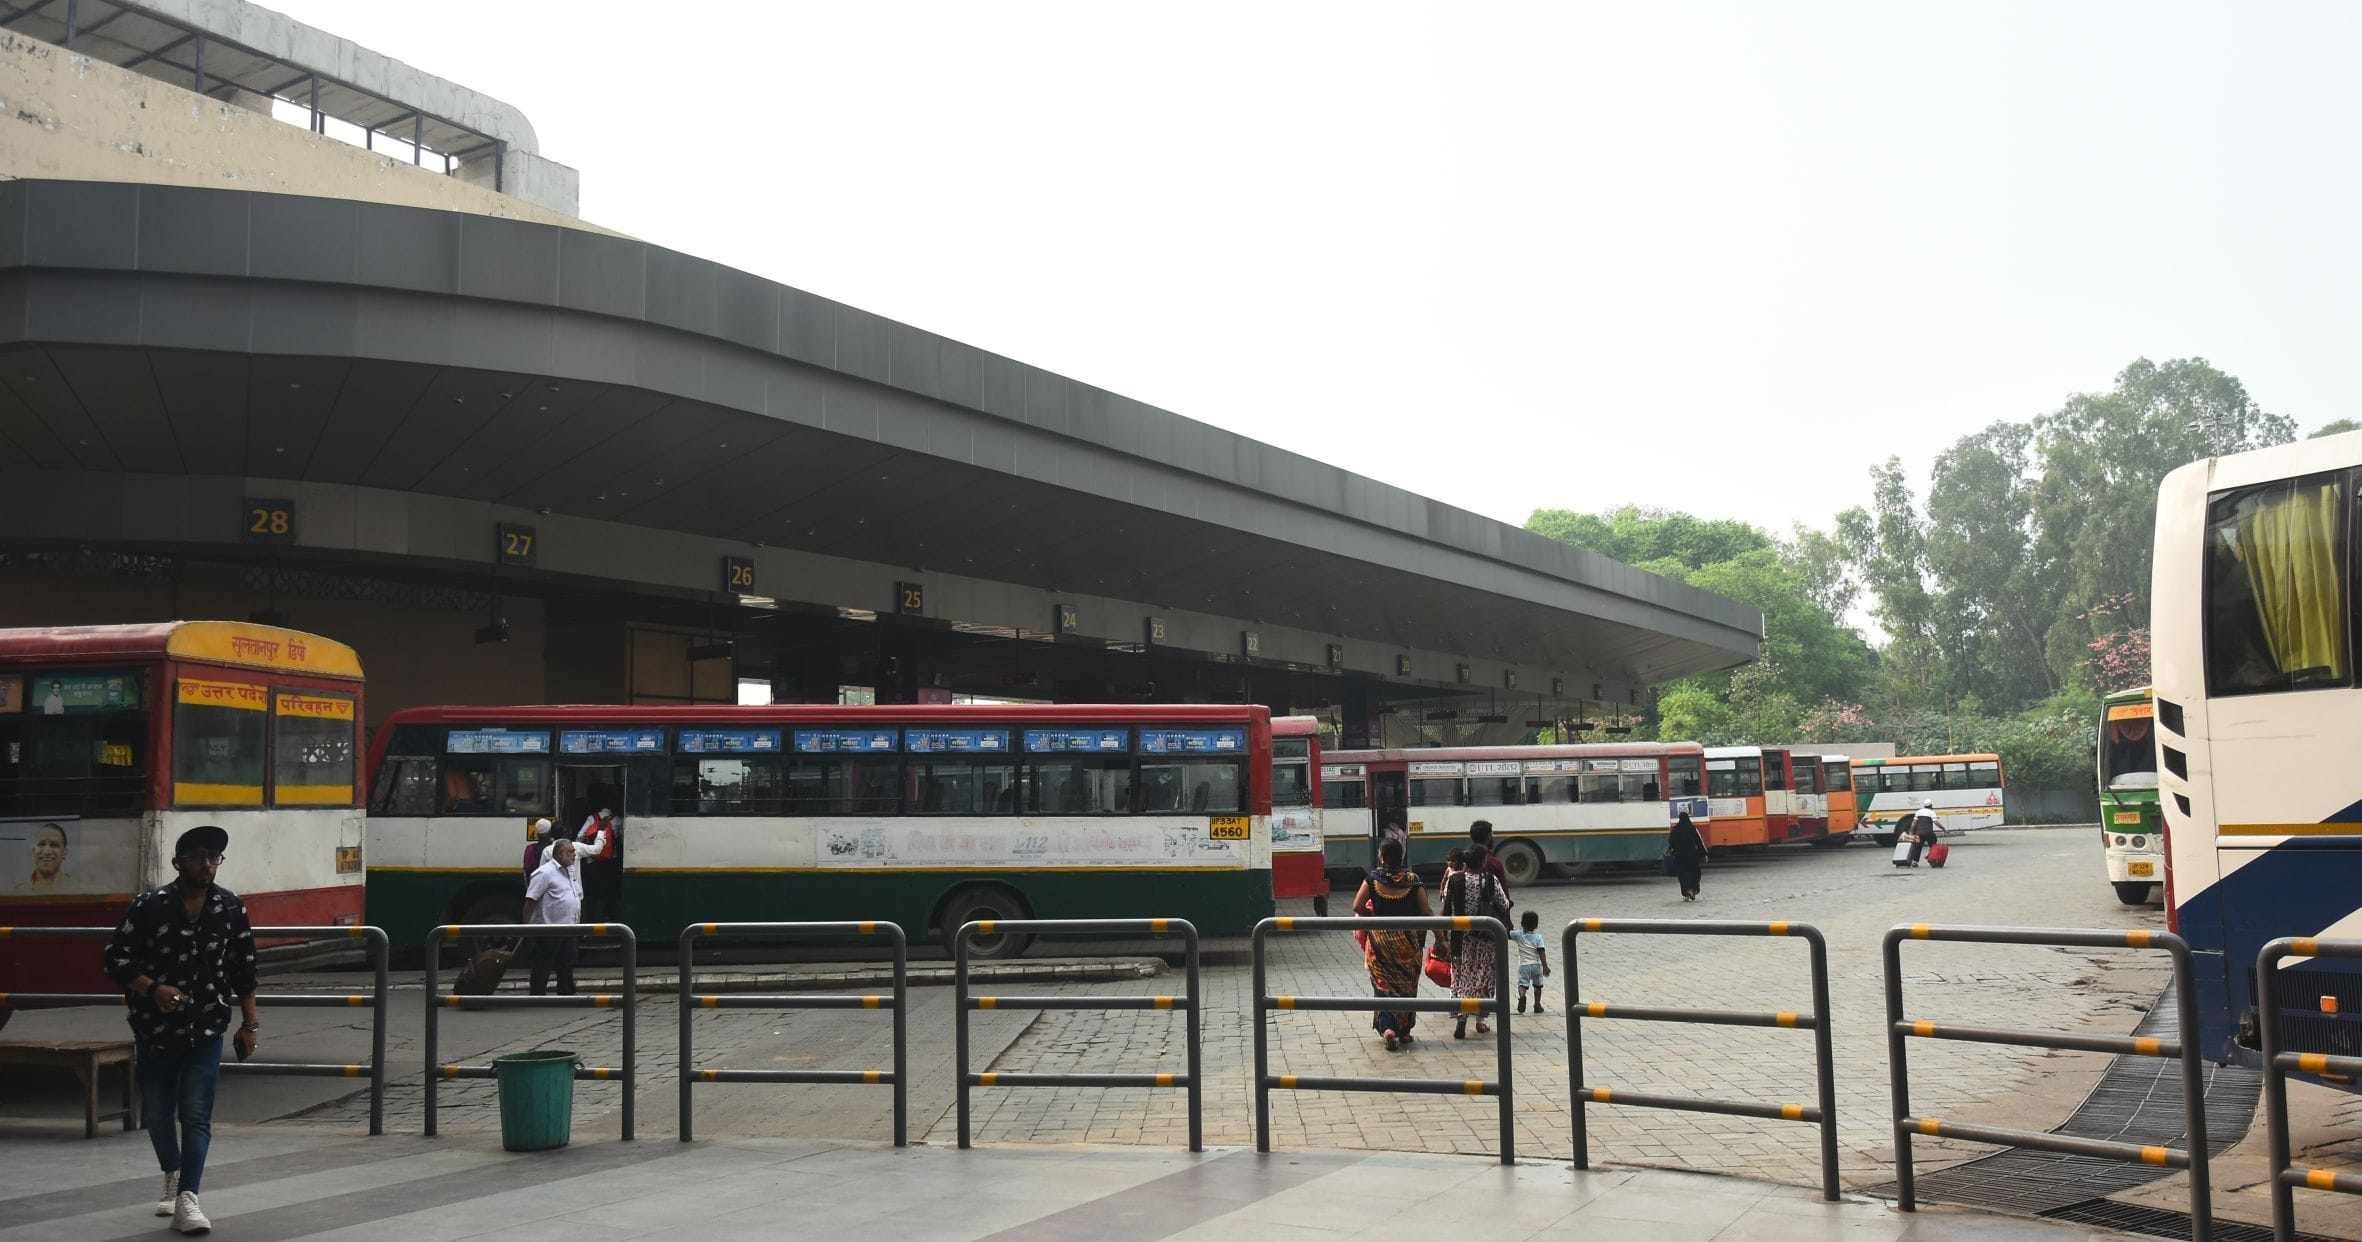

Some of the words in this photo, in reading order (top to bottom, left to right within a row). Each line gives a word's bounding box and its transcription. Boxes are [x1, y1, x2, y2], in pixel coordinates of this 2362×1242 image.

[250, 507, 289, 535] 28
[506, 533, 532, 556] 27
[731, 565, 752, 586] 26
[904, 590, 921, 609] 25
[1063, 611, 1077, 629] 24
[1153, 623, 1164, 639] 23
[288, 638, 306, 662] डिपो
[1248, 636, 1258, 651] 22
[1332, 648, 1342, 662] 21
[1402, 660, 1410, 672] 20
[200, 684, 234, 699] उत्तर
[280, 696, 333, 715] परिवहन
[1211, 817, 1242, 825] UP33AT
[1212, 827, 1243, 838] 4560
